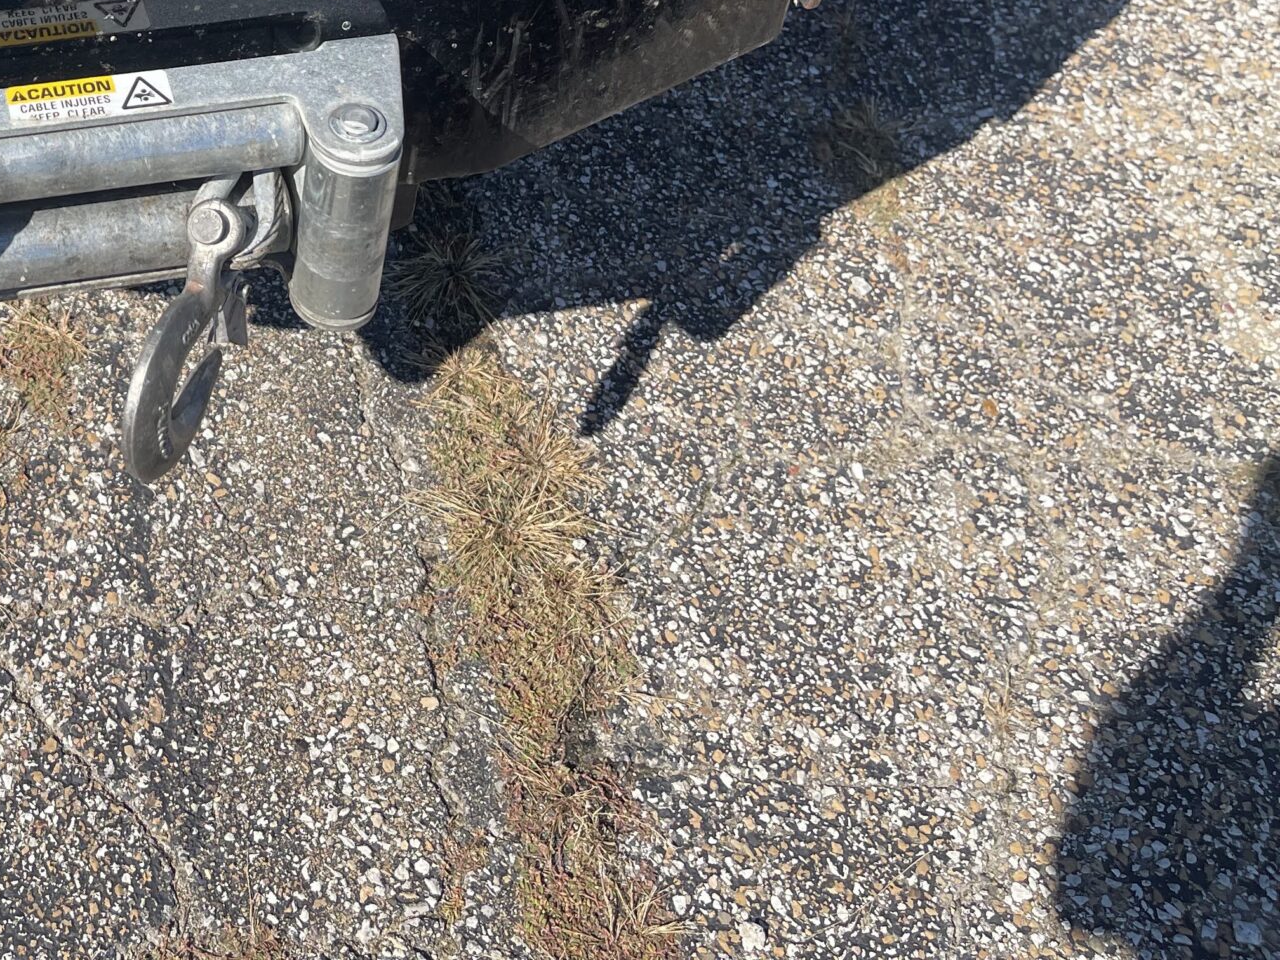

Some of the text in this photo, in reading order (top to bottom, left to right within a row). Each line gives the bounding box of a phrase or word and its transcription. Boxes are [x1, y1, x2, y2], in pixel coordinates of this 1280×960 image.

[27, 79, 111, 100] CAUTION
[20, 94, 111, 113] CABLE INJURES
